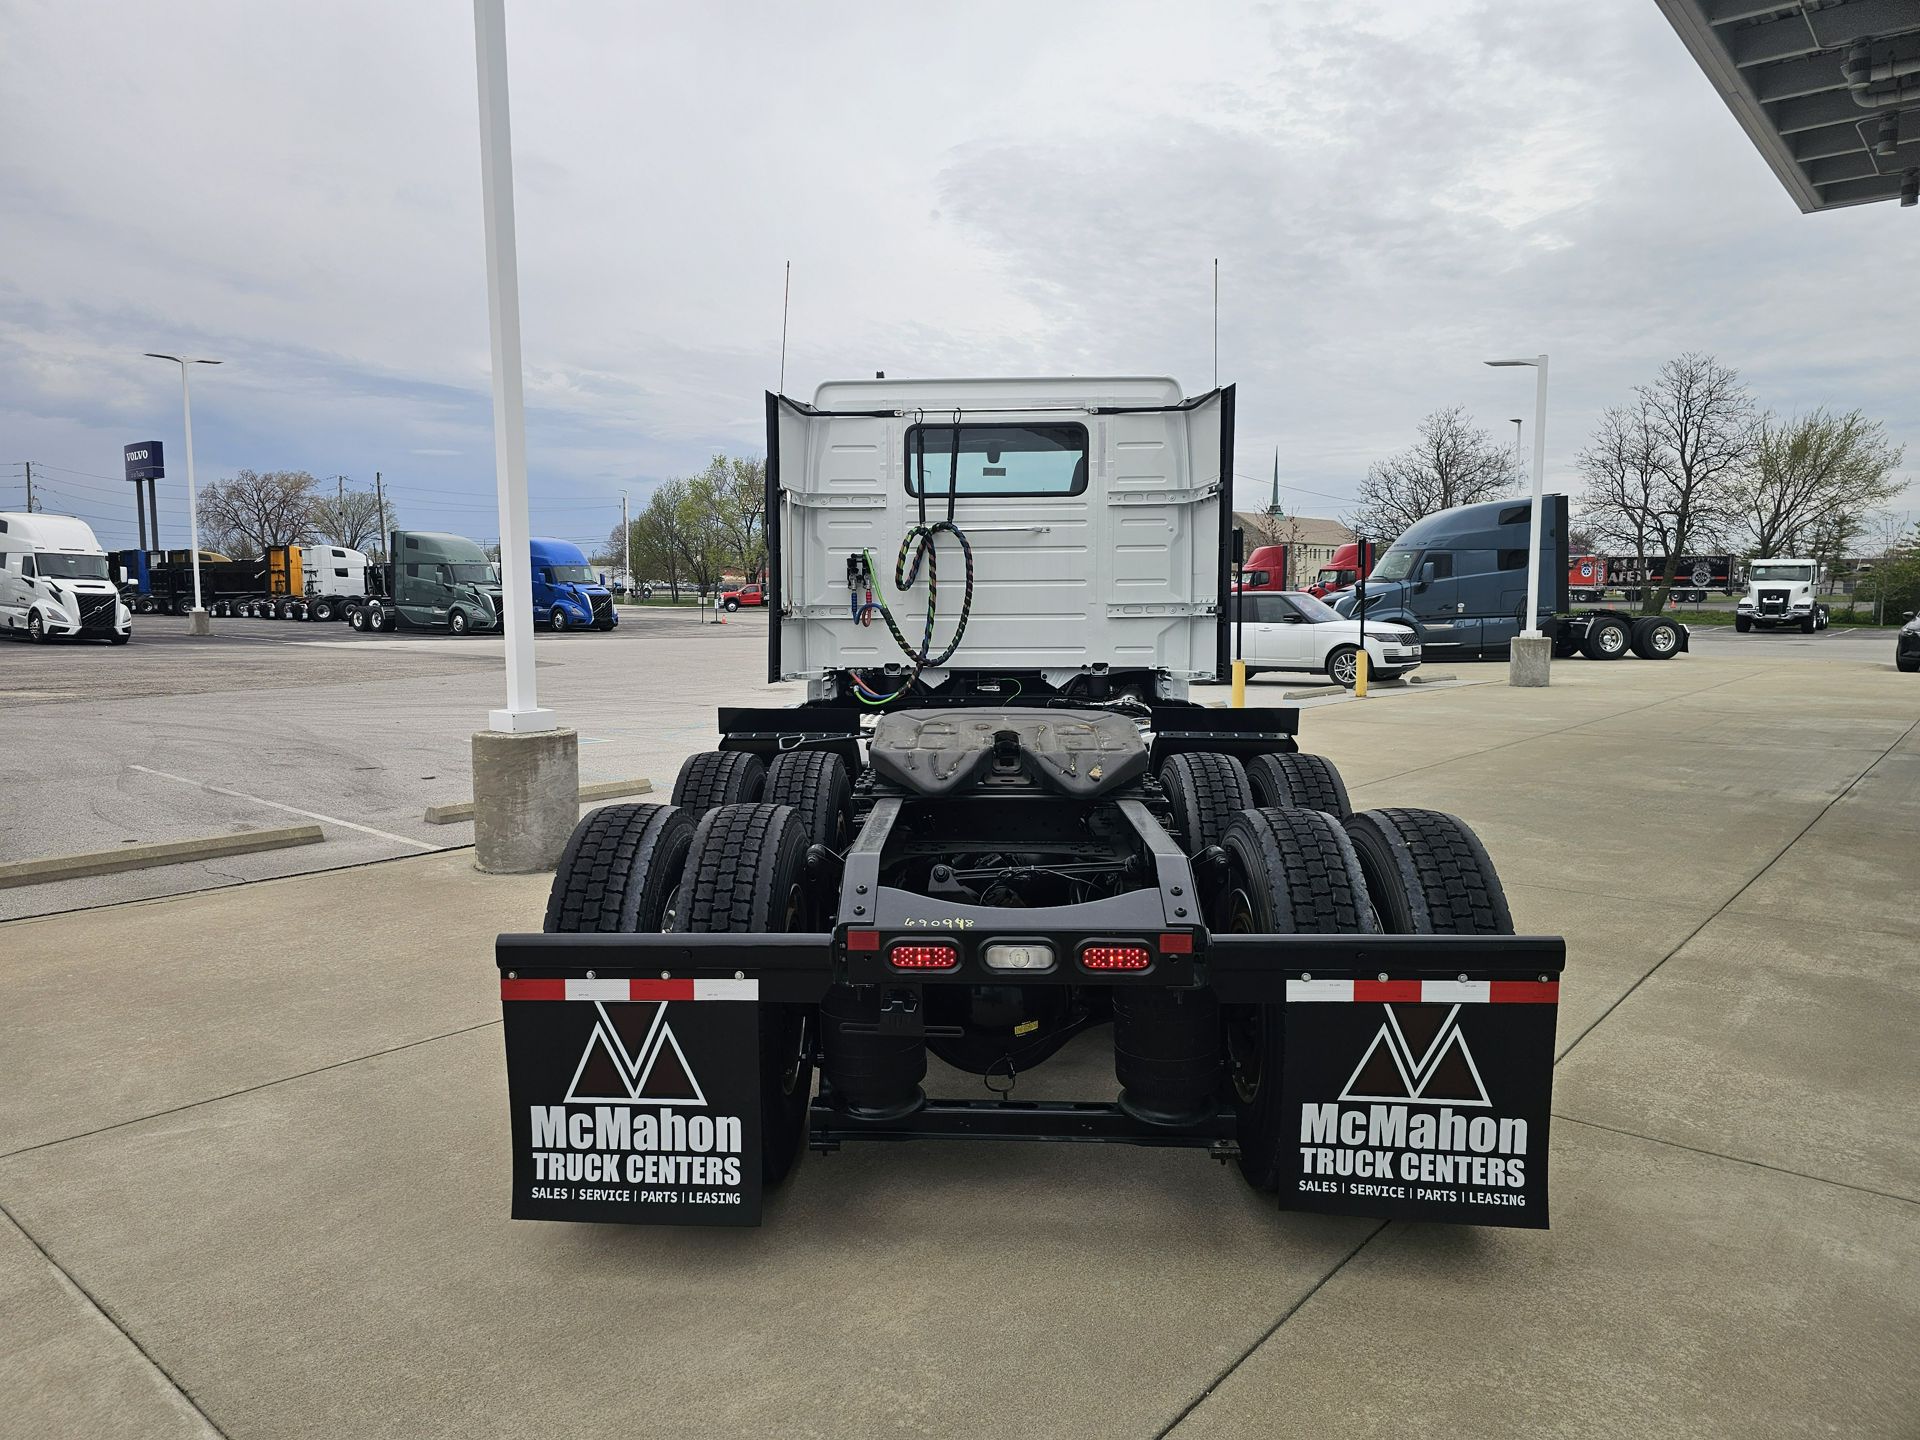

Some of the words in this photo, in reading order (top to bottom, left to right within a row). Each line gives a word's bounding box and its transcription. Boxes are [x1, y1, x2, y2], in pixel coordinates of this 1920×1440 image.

[126, 449, 148, 462] VOLVO
[530, 1105, 742, 1153] McMahon
[1300, 1103, 1528, 1155] McMahon
[532, 1152, 621, 1182] TRUCK
[626, 1154, 741, 1186] CENTERS
[1300, 1147, 1394, 1179] TRUCK
[1400, 1152, 1526, 1188] CENTERS
[531, 1187, 568, 1200] SALES
[579, 1188, 630, 1202] SERVICE
[640, 1190, 678, 1203] PARTS
[688, 1192, 741, 1205] LEASING
[1299, 1180, 1338, 1193] SALES
[1349, 1183, 1405, 1199] SERVICE
[1416, 1188, 1457, 1203] PARTS
[1469, 1191, 1526, 1207] LEASING
